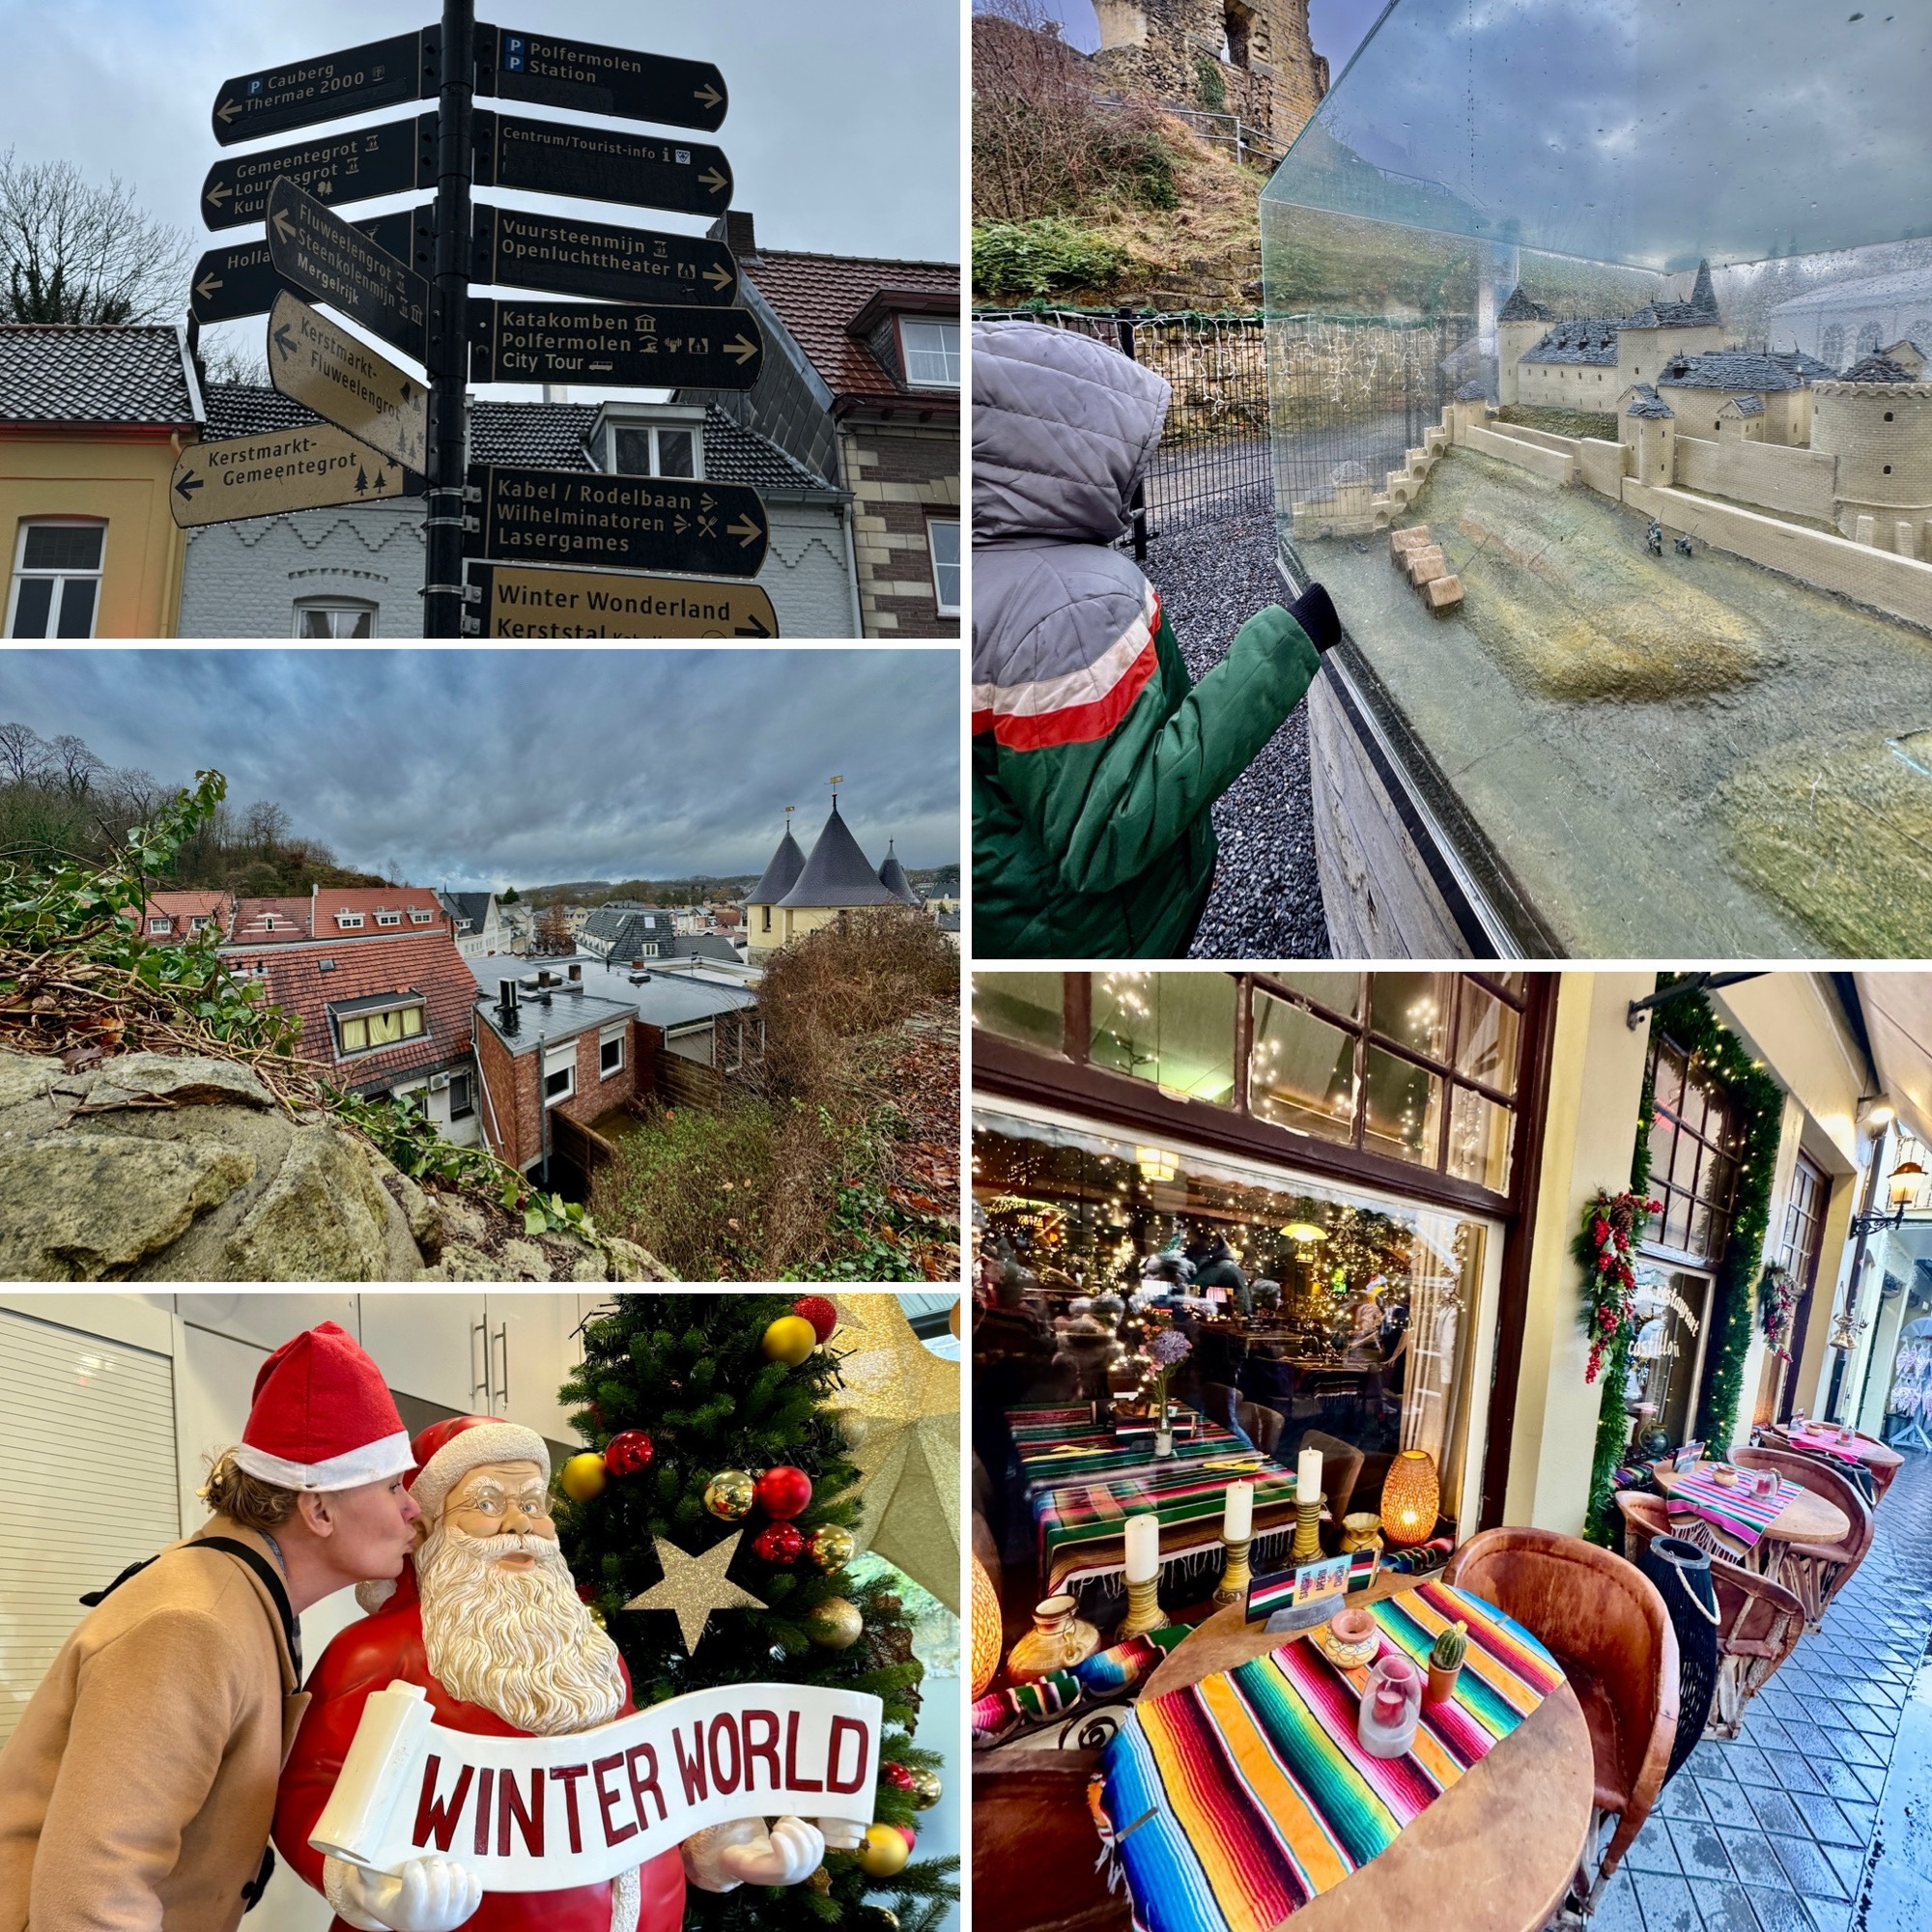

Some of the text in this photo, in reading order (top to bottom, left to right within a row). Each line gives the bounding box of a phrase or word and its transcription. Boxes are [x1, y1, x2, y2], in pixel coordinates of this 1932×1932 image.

[529, 60, 596, 83] Station
[530, 43, 641, 73] Polfermolen
[244, 71, 364, 112] Thermae 2000
[268, 64, 334, 90] Cauberg
[237, 140, 357, 179] Gemeentegrot
[503, 127, 656, 160] Centrum/Tourist-info
[299, 203, 392, 282] Fluweelengrot
[502, 218, 645, 255] Vuursteenmijn
[298, 228, 396, 307] Steenkolenmijn
[501, 240, 670, 276] Openluchttheater
[297, 252, 359, 305] Mergelrijk
[502, 311, 628, 330] Katakomben
[300, 316, 378, 380] Kerstmarkt-
[502, 332, 631, 353] Polfermolen
[502, 353, 583, 373] City Tour
[310, 351, 401, 421] Fluweelengrot
[208, 438, 318, 468] Kerstmarkt-
[222, 451, 357, 487] Gemeentegrot
[497, 479, 692, 510] Kabel / Rodelbaan
[497, 503, 665, 532] Wilhelminatoren
[498, 526, 629, 553] Lasergames
[497, 583, 730, 621] Winter Wonderland
[497, 617, 606, 639] Kerststal
[412, 1709, 868, 1858] WINTER WORLD
